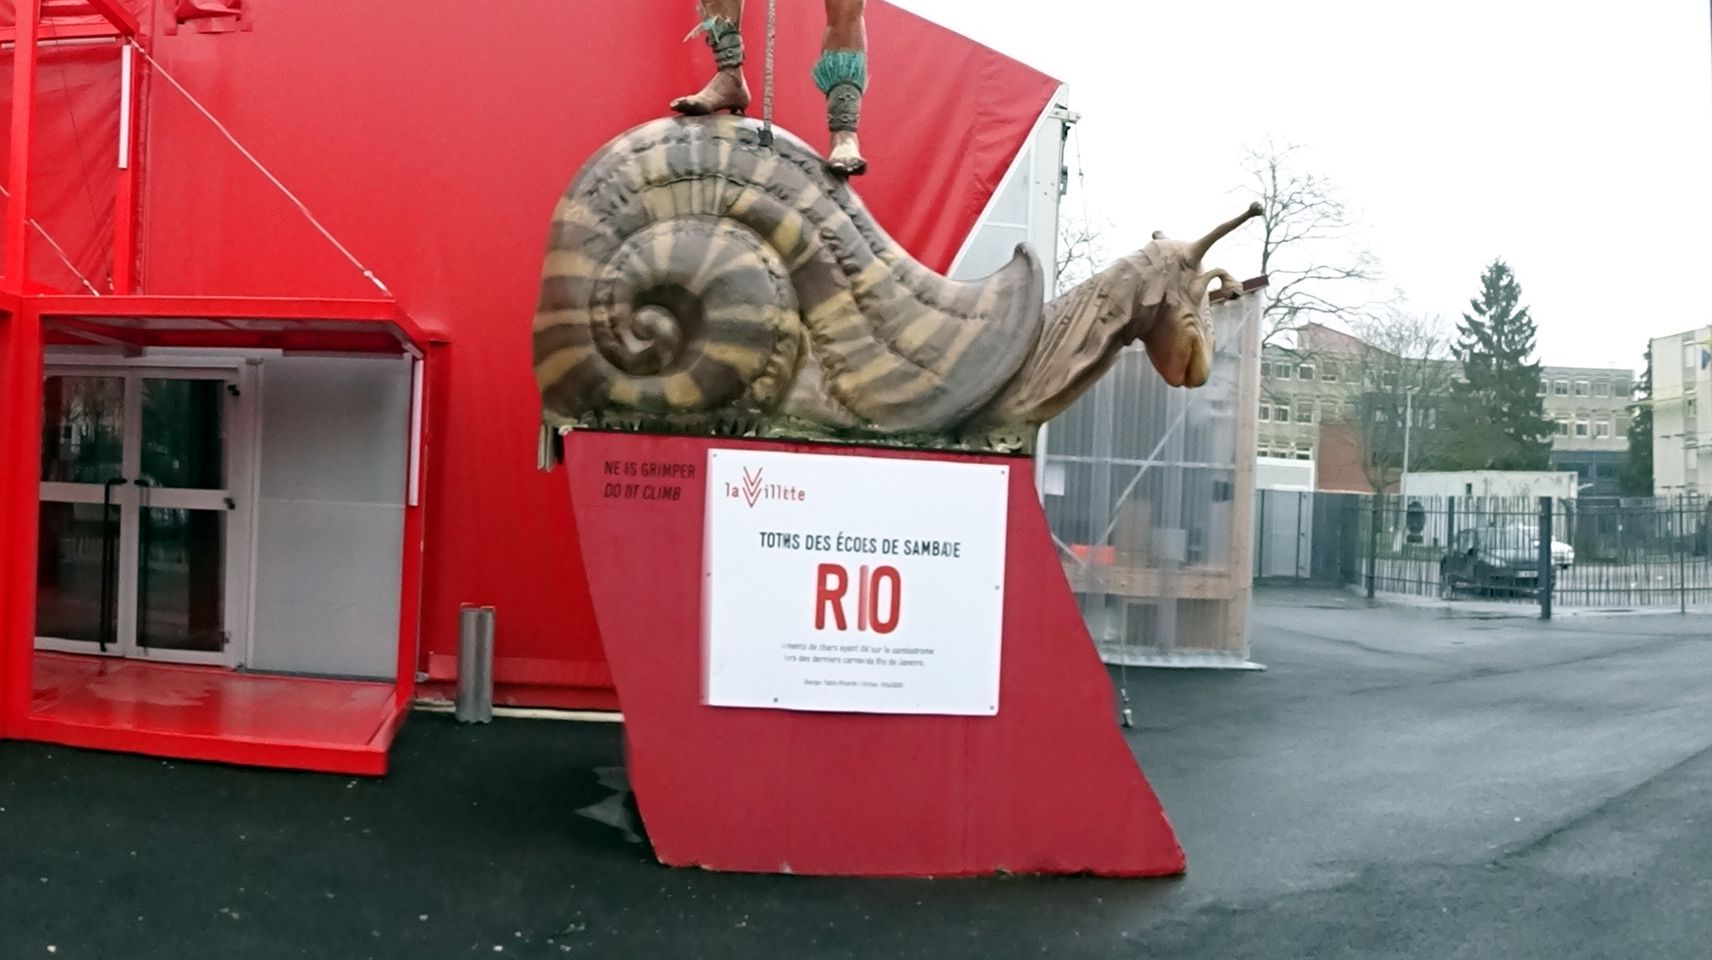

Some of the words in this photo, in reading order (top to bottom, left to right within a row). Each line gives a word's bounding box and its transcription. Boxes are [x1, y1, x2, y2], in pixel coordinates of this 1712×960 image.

[604, 461, 621, 475] NE
[641, 462, 696, 479] GRIMPER
[603, 482, 622, 498] DO
[642, 485, 682, 501] CLIMB
[805, 534, 831, 551] DES
[882, 538, 899, 555] DE
[814, 562, 902, 634] RIO
